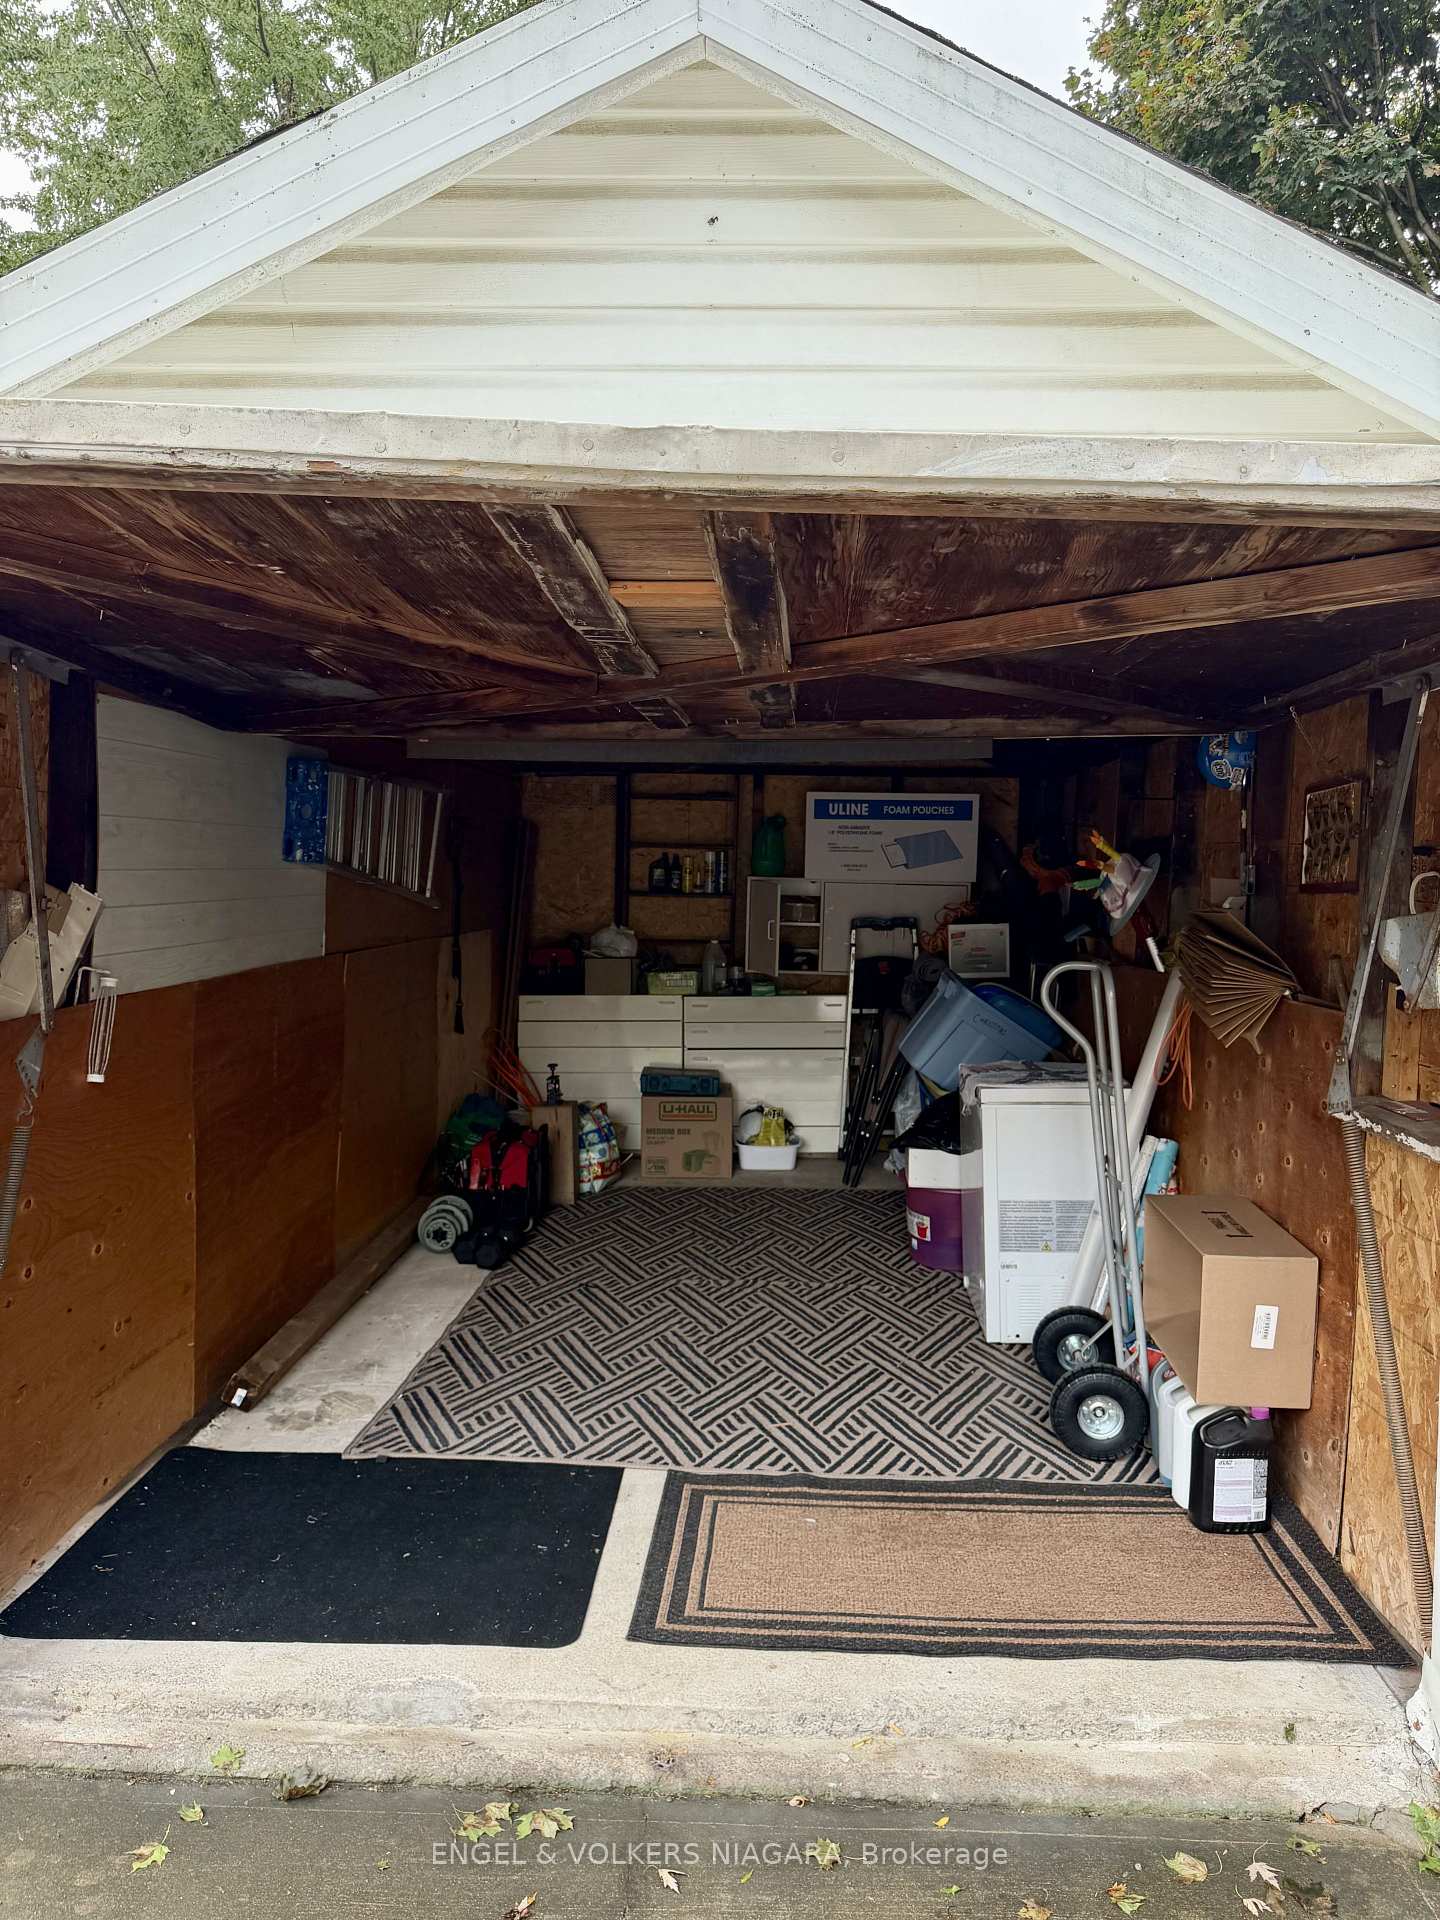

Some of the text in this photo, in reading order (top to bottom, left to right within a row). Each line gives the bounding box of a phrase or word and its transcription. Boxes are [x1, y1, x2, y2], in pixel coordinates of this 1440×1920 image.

[828, 803, 955, 816] ULINE FOAM POUCHES
[662, 1104, 713, 1114] U-HAUL
